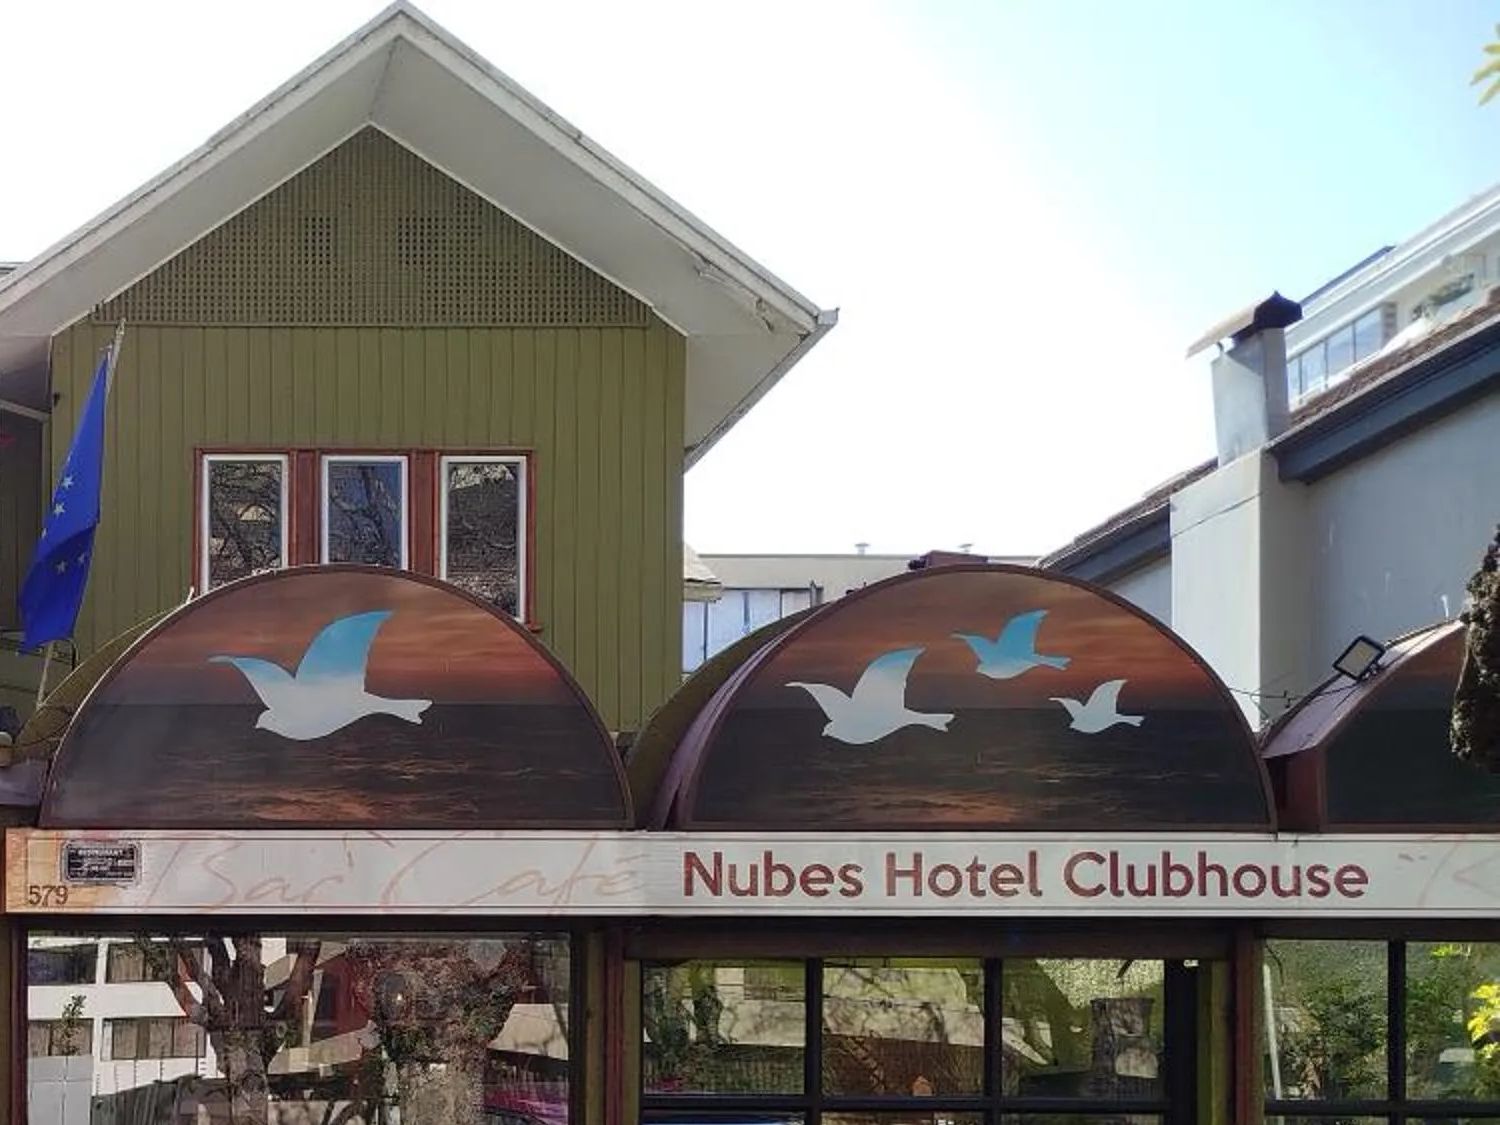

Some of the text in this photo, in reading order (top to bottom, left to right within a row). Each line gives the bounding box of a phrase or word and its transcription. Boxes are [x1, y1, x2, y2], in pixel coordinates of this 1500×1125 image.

[683, 851, 865, 897] Nubes
[886, 851, 1043, 897] Hotel
[1063, 851, 1369, 898] Clubhouse
[29, 885, 68, 906] 579
